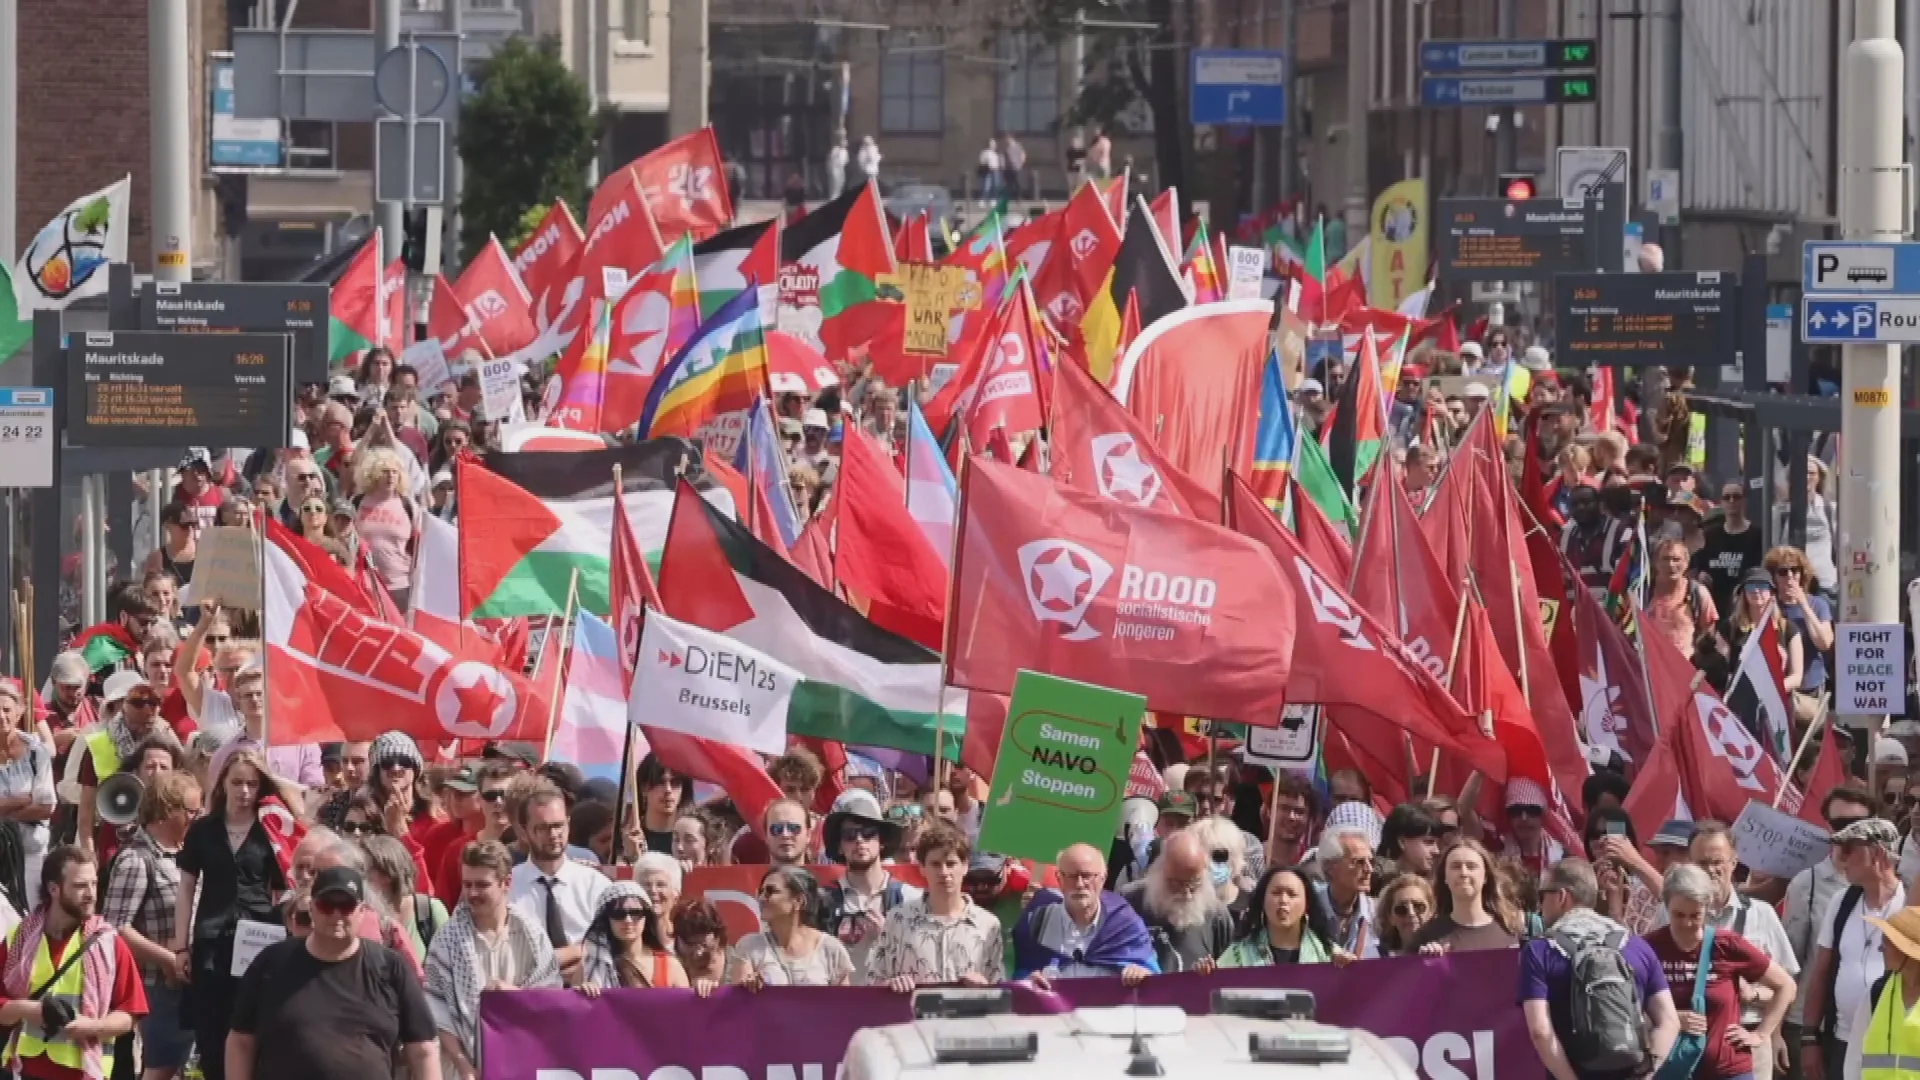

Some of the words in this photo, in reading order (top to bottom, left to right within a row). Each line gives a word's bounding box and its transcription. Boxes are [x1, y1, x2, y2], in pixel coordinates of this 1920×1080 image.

[1525, 212, 1584, 222] Mauritskade
[1817, 253, 1840, 282] P
[1655, 287, 1721, 299] Mauritskade
[156, 299, 225, 311] Mauritskade
[913, 308, 944, 325] WAR
[1879, 311, 1920, 327] Rou
[85, 352, 164, 365] Mauritskade
[234, 374, 266, 384] Vertrek
[1854, 390, 1889, 404] M0870
[2, 425, 20, 438] 24
[24, 425, 43, 438] 22
[1118, 563, 1217, 609] ROOD
[1116, 601, 1212, 625] socialistische
[1112, 618, 1176, 641] jongeren
[1849, 630, 1892, 643] FIGHT
[1855, 647, 1885, 660] FOR
[1847, 663, 1894, 676] PEACE
[1855, 680, 1886, 693] NOT
[678, 686, 752, 717] Brussels
[1853, 697, 1888, 709] WAR
[1038, 721, 1101, 751] Samen
[1031, 745, 1097, 775] NAVO
[1020, 768, 1096, 800] Stoppen
